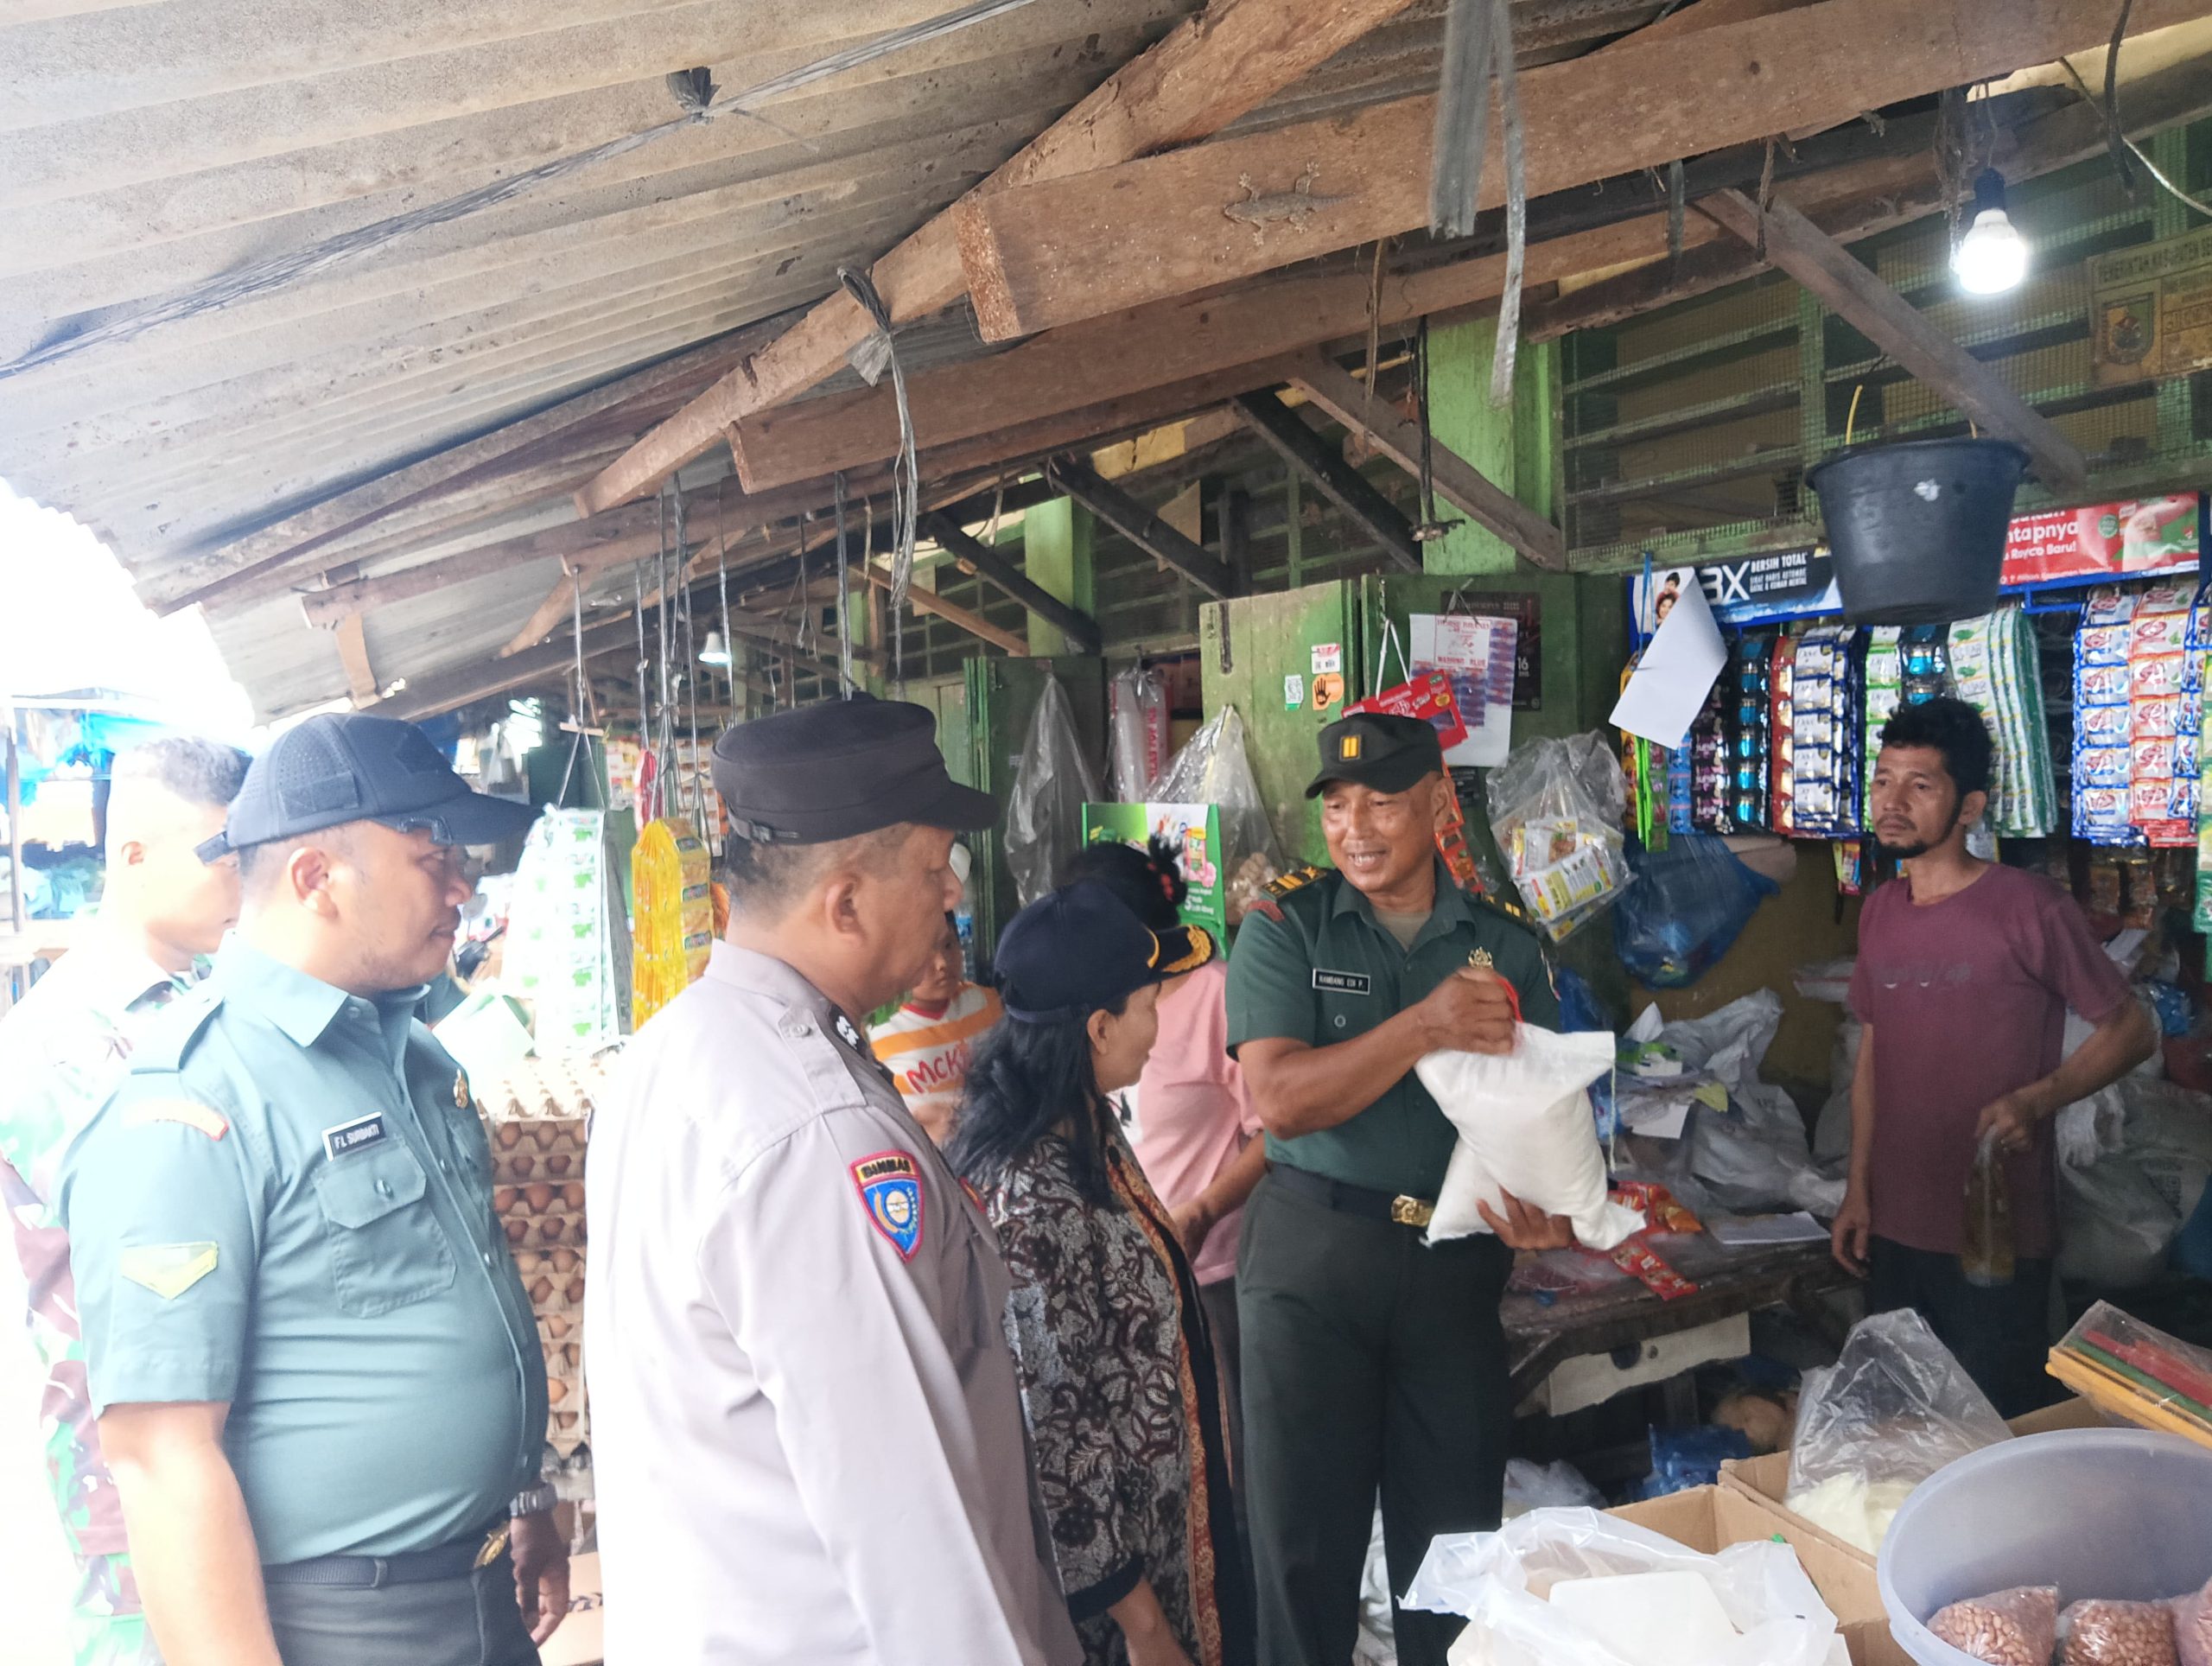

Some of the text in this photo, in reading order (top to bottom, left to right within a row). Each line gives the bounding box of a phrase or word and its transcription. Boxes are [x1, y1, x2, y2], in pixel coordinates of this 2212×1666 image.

[2011, 541, 2076, 561] Royco Baru!
[1751, 552, 1807, 573] BERSIH TOTAL
[1700, 561, 1751, 606] 3X
[1517, 657, 1529, 671] 16
